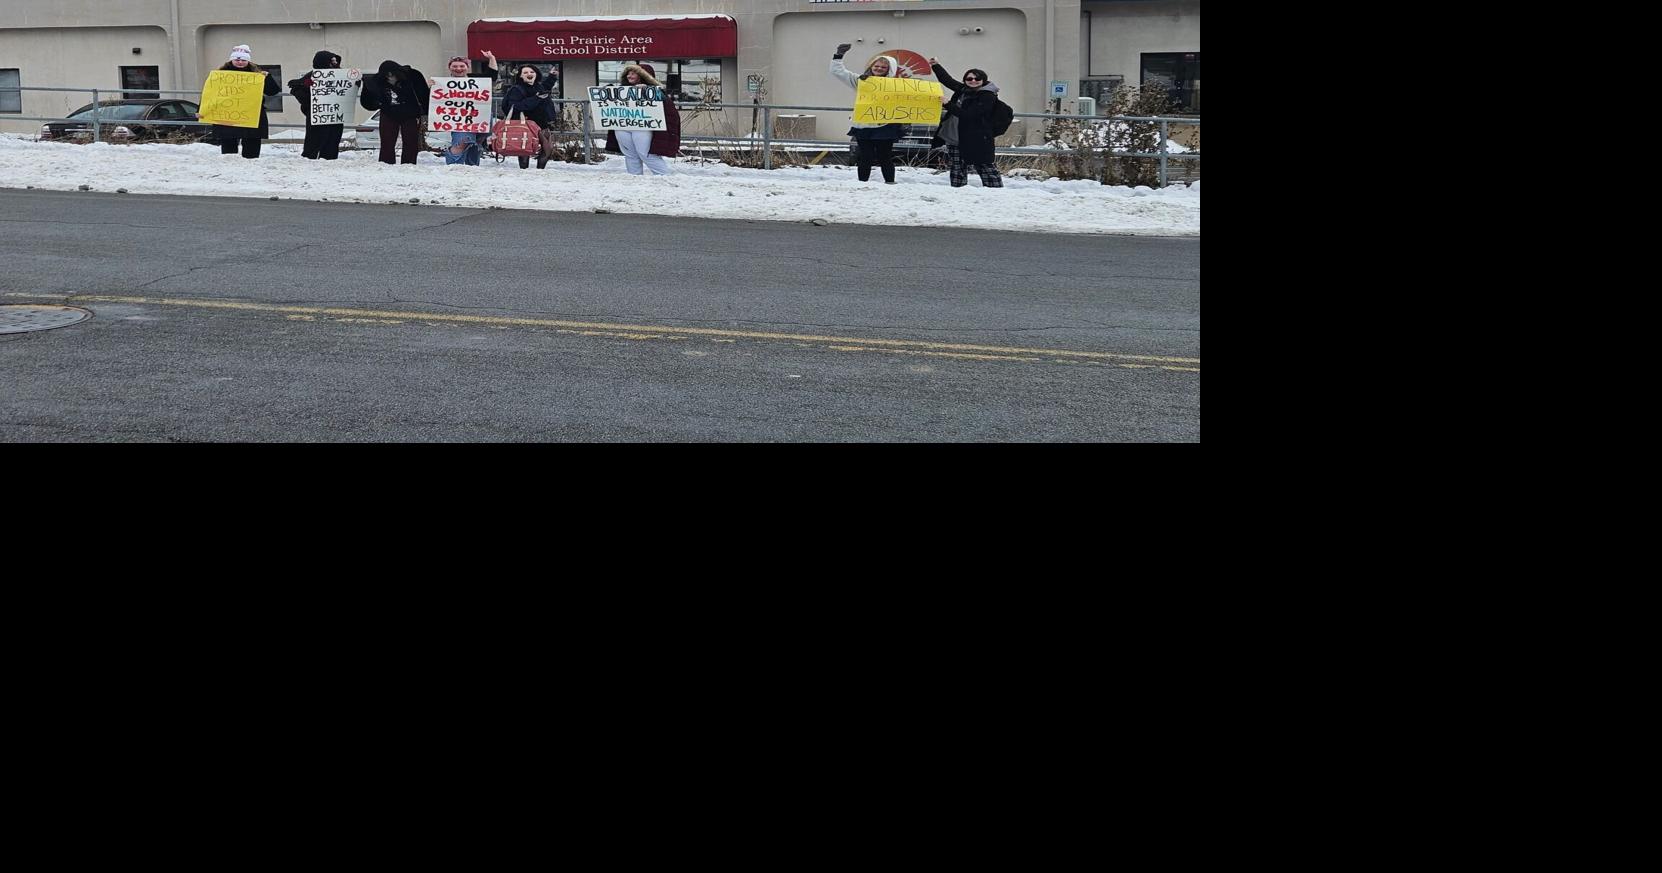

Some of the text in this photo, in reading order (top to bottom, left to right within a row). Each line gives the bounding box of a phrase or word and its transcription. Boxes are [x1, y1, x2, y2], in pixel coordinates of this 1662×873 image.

[537, 35, 653, 45] Sun Prairie Area
[543, 45, 647, 55] School District
[312, 70, 335, 79] OUR
[311, 80, 352, 88] STUDENTS
[446, 79, 479, 90] OUR
[218, 86, 246, 96] KIDS
[311, 87, 348, 96] DESERVE
[431, 88, 490, 101] SCHOOLS
[589, 86, 665, 102] EDUCATION
[208, 98, 246, 109] NOT
[312, 103, 340, 113] BETTER
[445, 100, 475, 110] OUR
[211, 110, 250, 120] PEDOS
[436, 106, 479, 117] KIDS
[601, 107, 652, 118] NATIONAL
[863, 105, 937, 121] ABUSERS
[442, 115, 473, 124] OUR
[601, 118, 663, 129] EMERGENCY
[433, 121, 489, 132] VOICES
